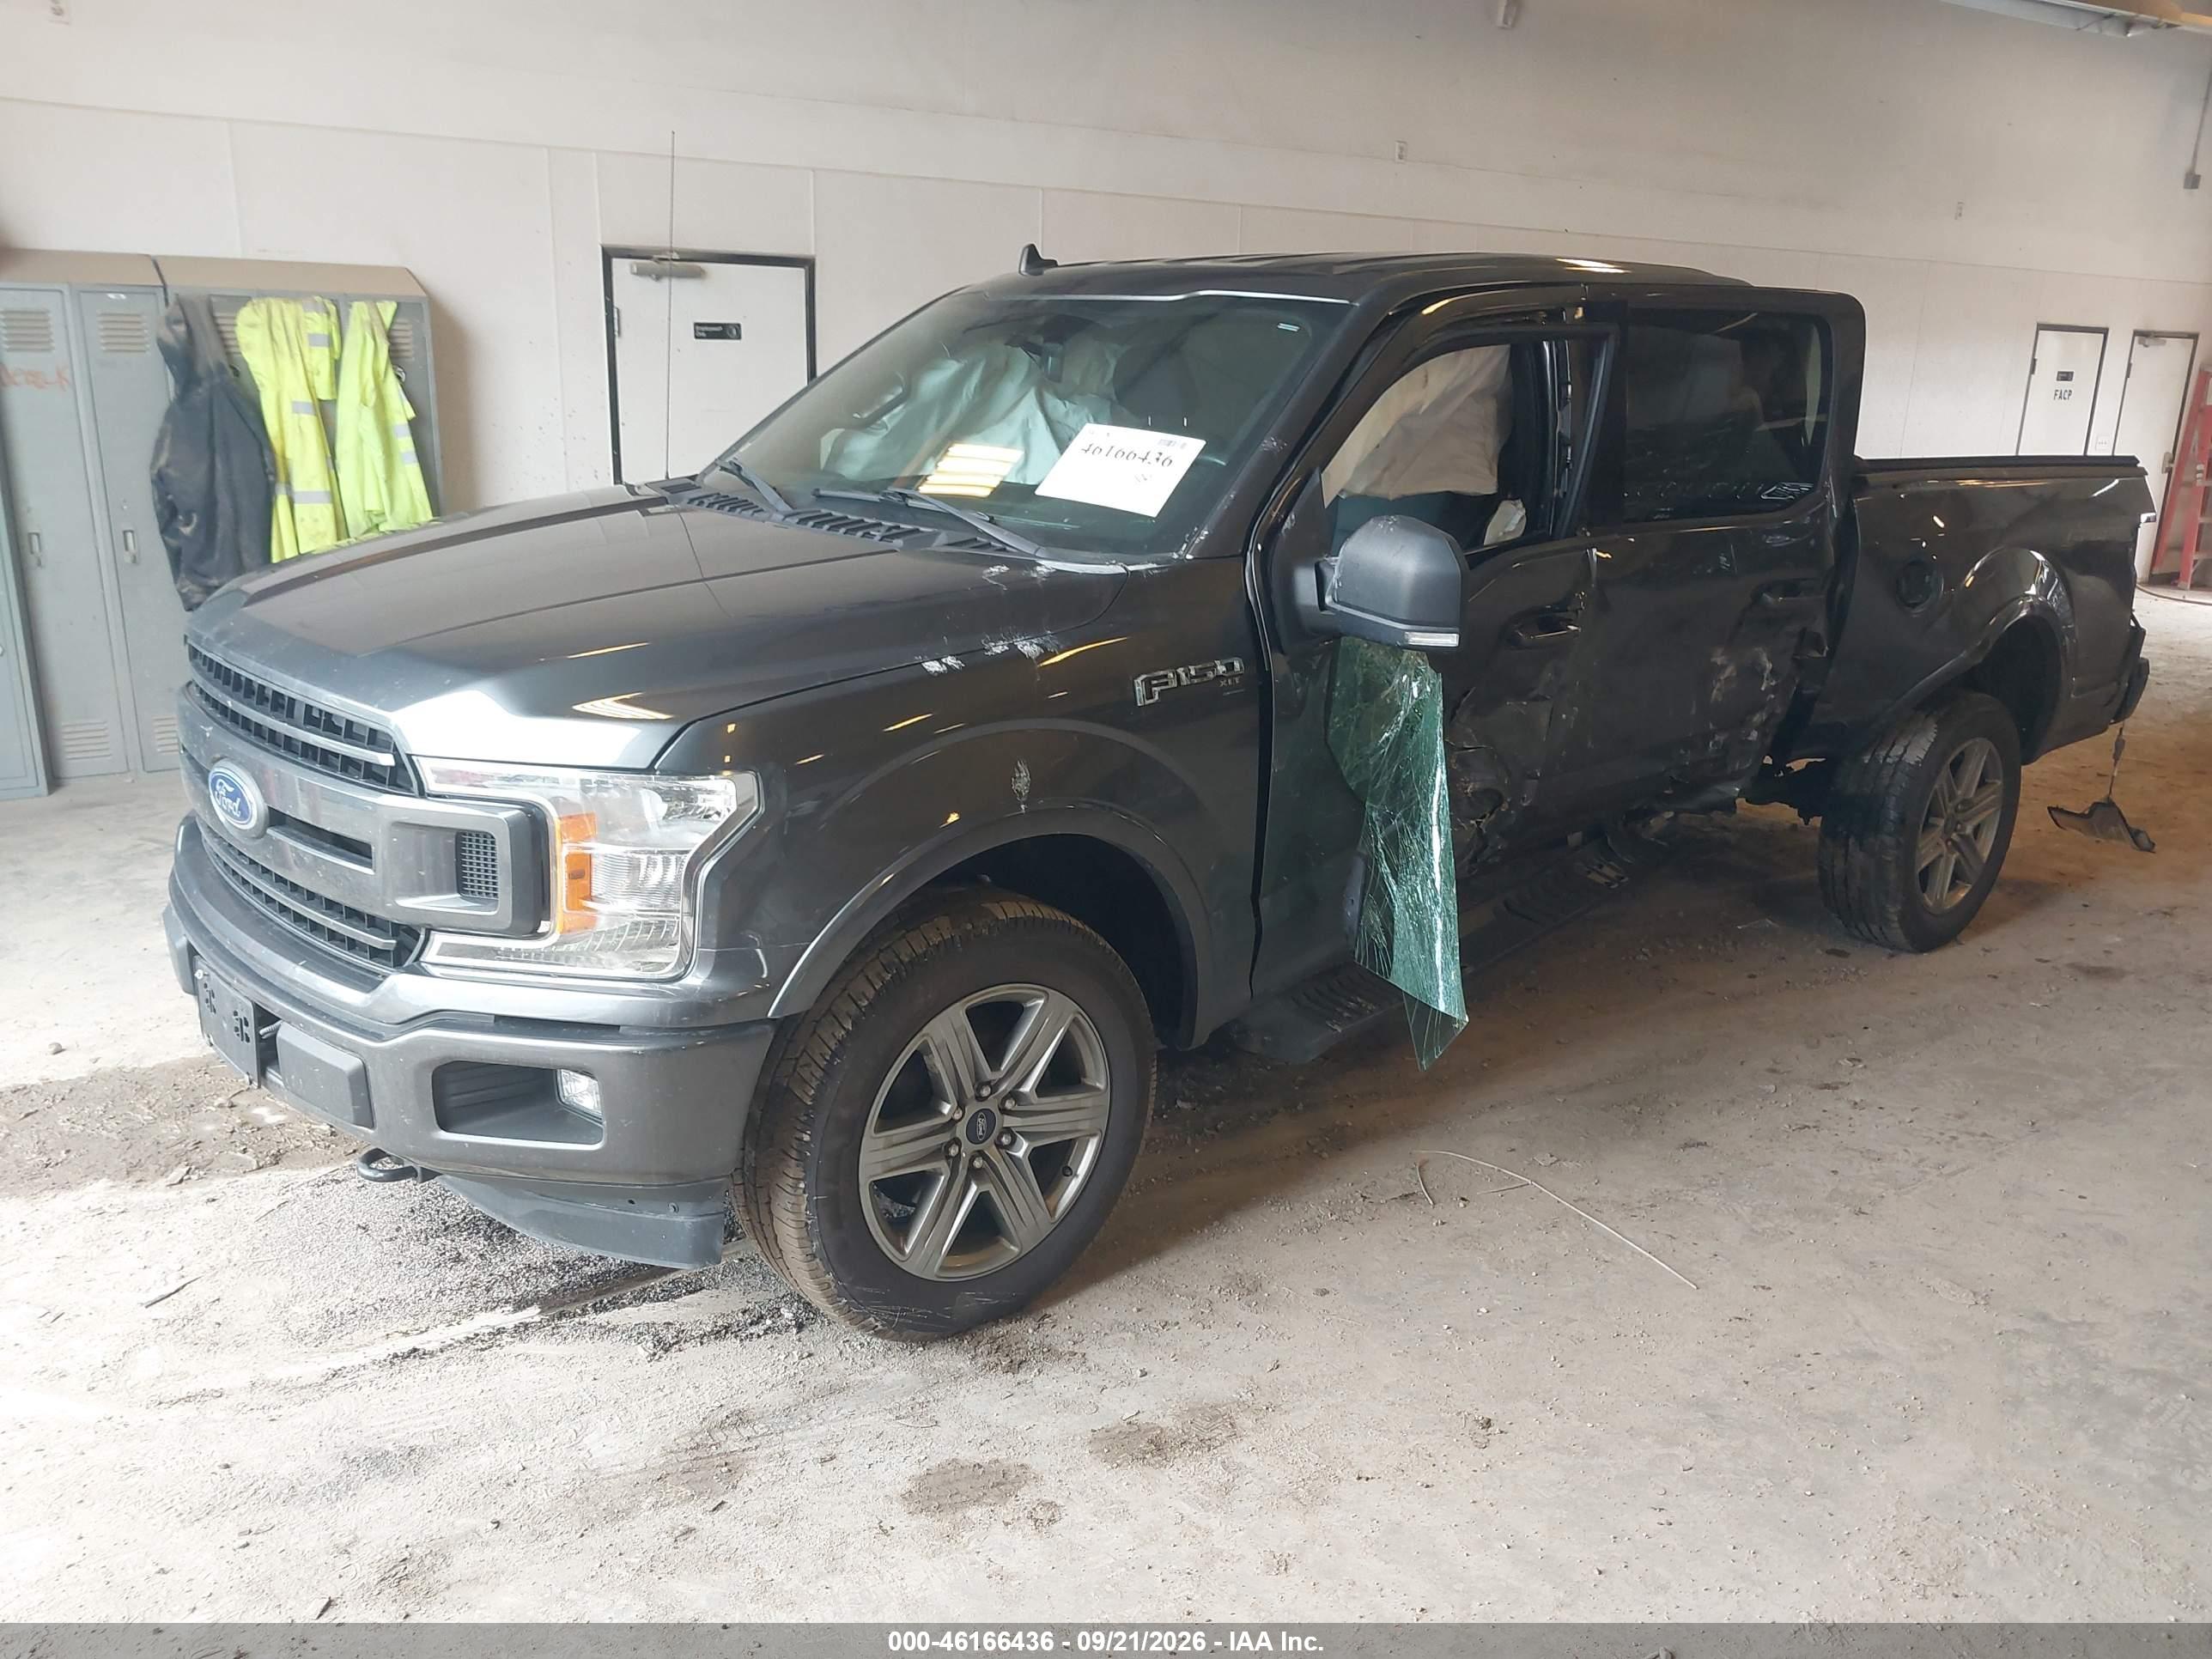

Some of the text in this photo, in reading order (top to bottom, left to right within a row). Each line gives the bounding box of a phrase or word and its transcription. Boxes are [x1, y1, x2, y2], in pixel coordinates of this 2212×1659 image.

[2053, 389, 2073, 401] FACP
[1080, 441, 1174, 468] 46166436
[215, 778, 242, 818] Ford
